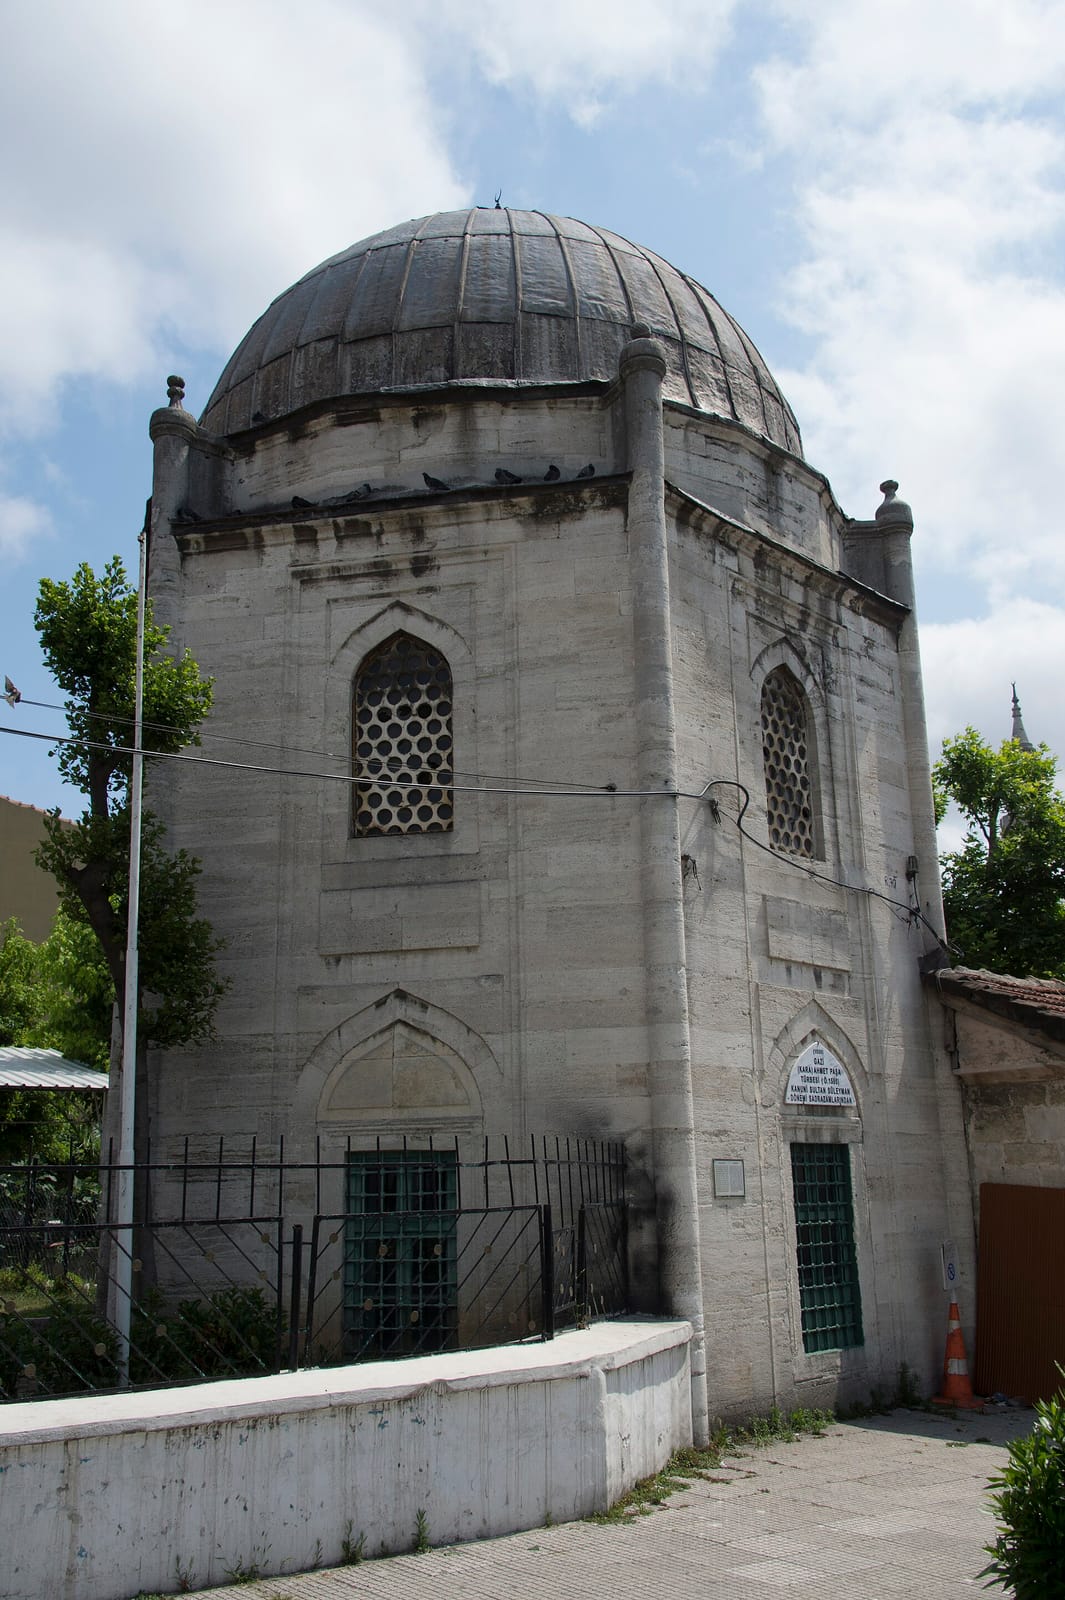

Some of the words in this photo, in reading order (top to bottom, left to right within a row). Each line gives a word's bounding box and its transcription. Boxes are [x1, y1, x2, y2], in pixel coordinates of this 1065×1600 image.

[814, 1067, 828, 1075] AHMET
[830, 1068, 841, 1077] PAŞA
[810, 1086, 826, 1094] SULTAN
[828, 1086, 850, 1095] SÜLEYMAN
